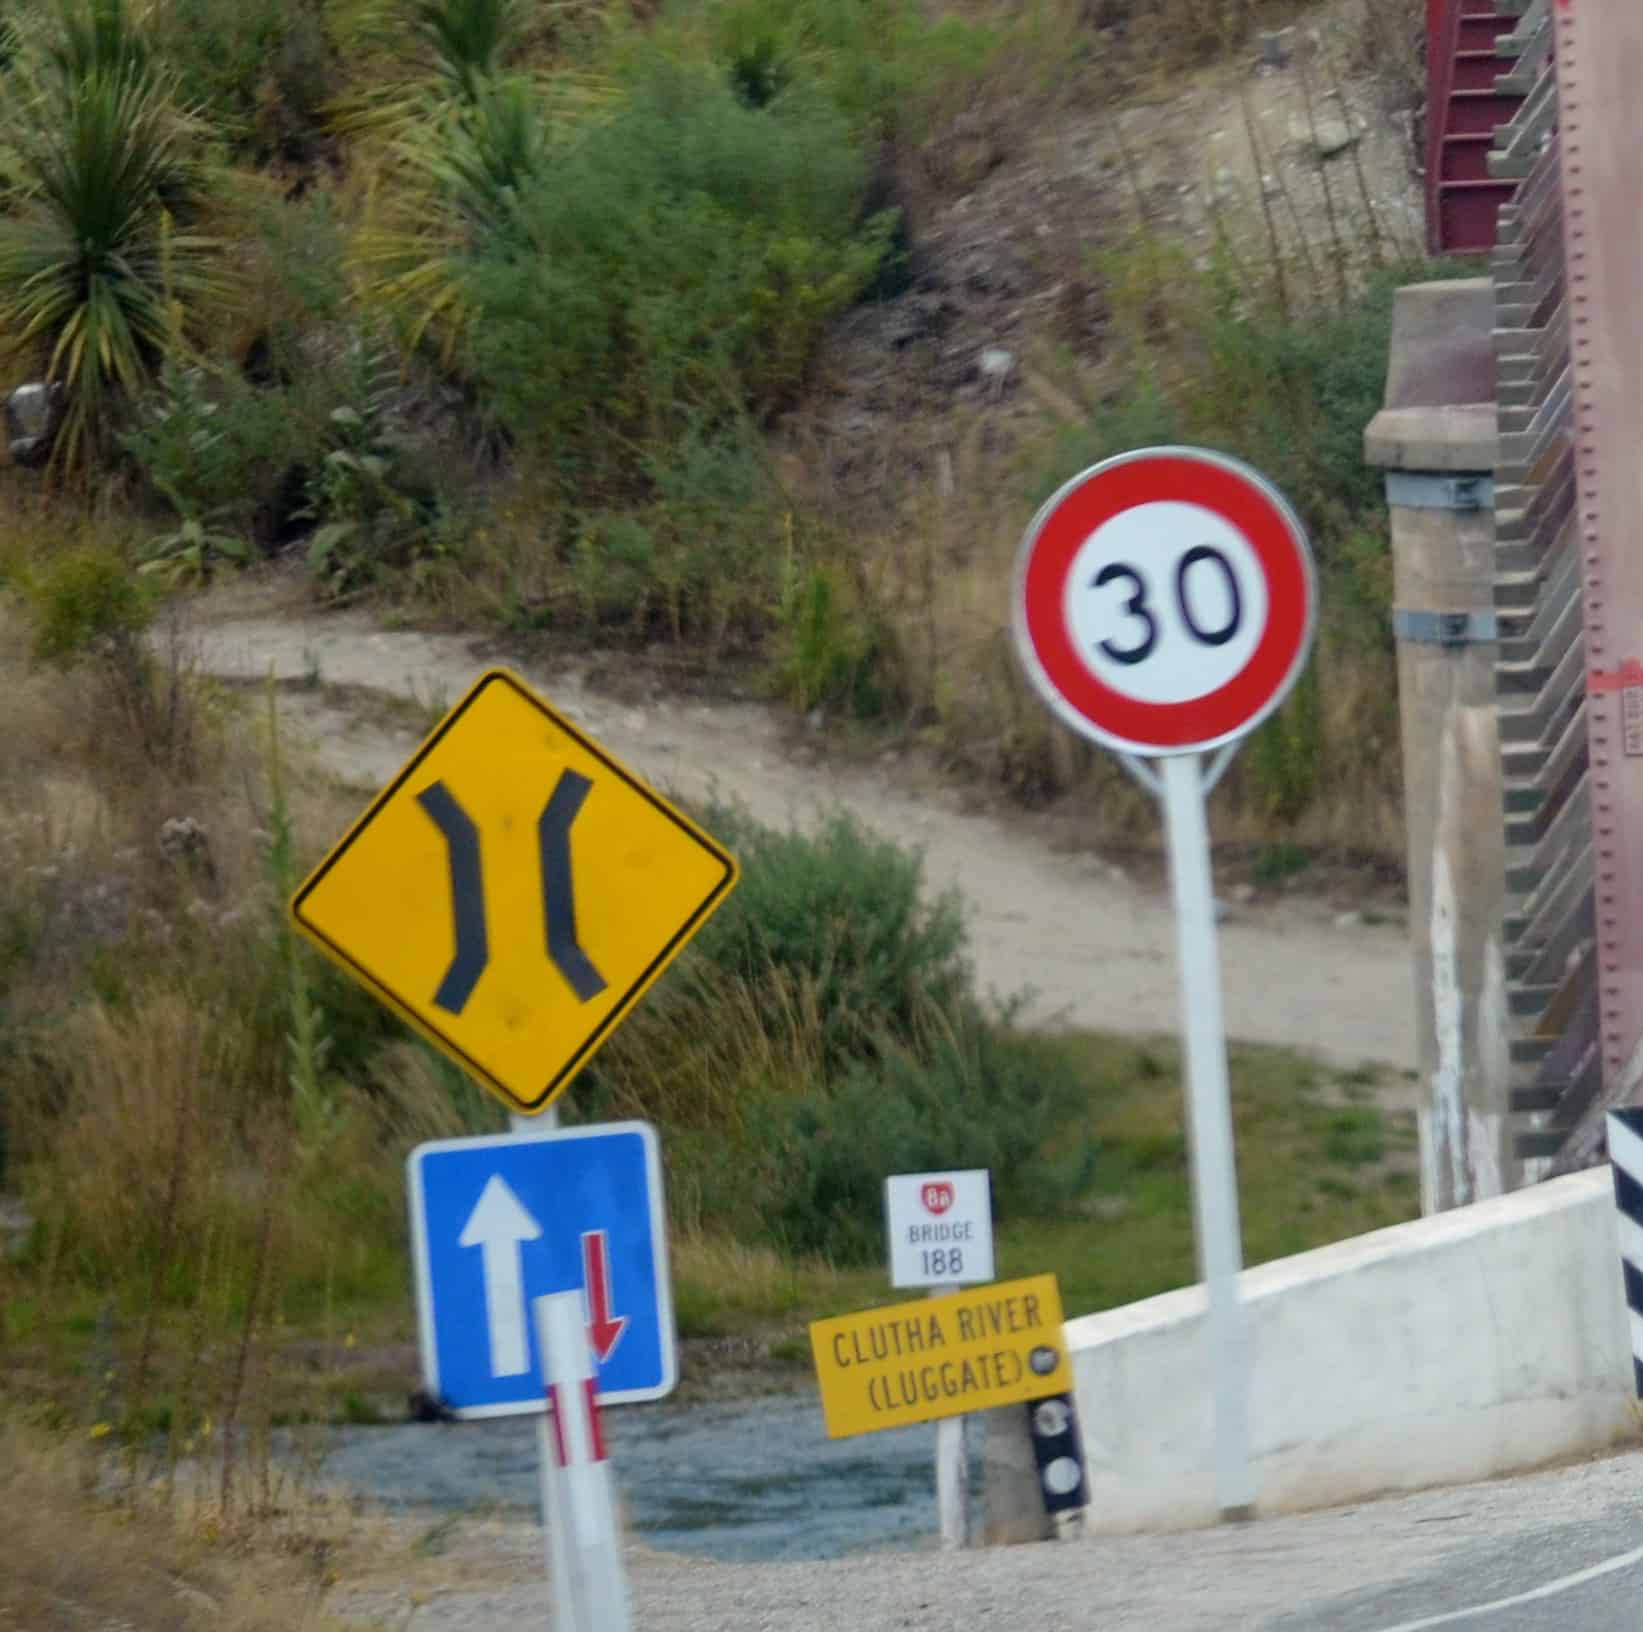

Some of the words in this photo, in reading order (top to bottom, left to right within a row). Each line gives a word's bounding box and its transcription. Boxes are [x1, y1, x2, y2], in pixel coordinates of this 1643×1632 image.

[1091, 545, 1242, 665] 30
[908, 1221, 975, 1244] BRIDGE
[922, 1247, 963, 1275] 188
[831, 1318, 947, 1369] CLUTHA
[957, 1294, 1043, 1341] RIVER
